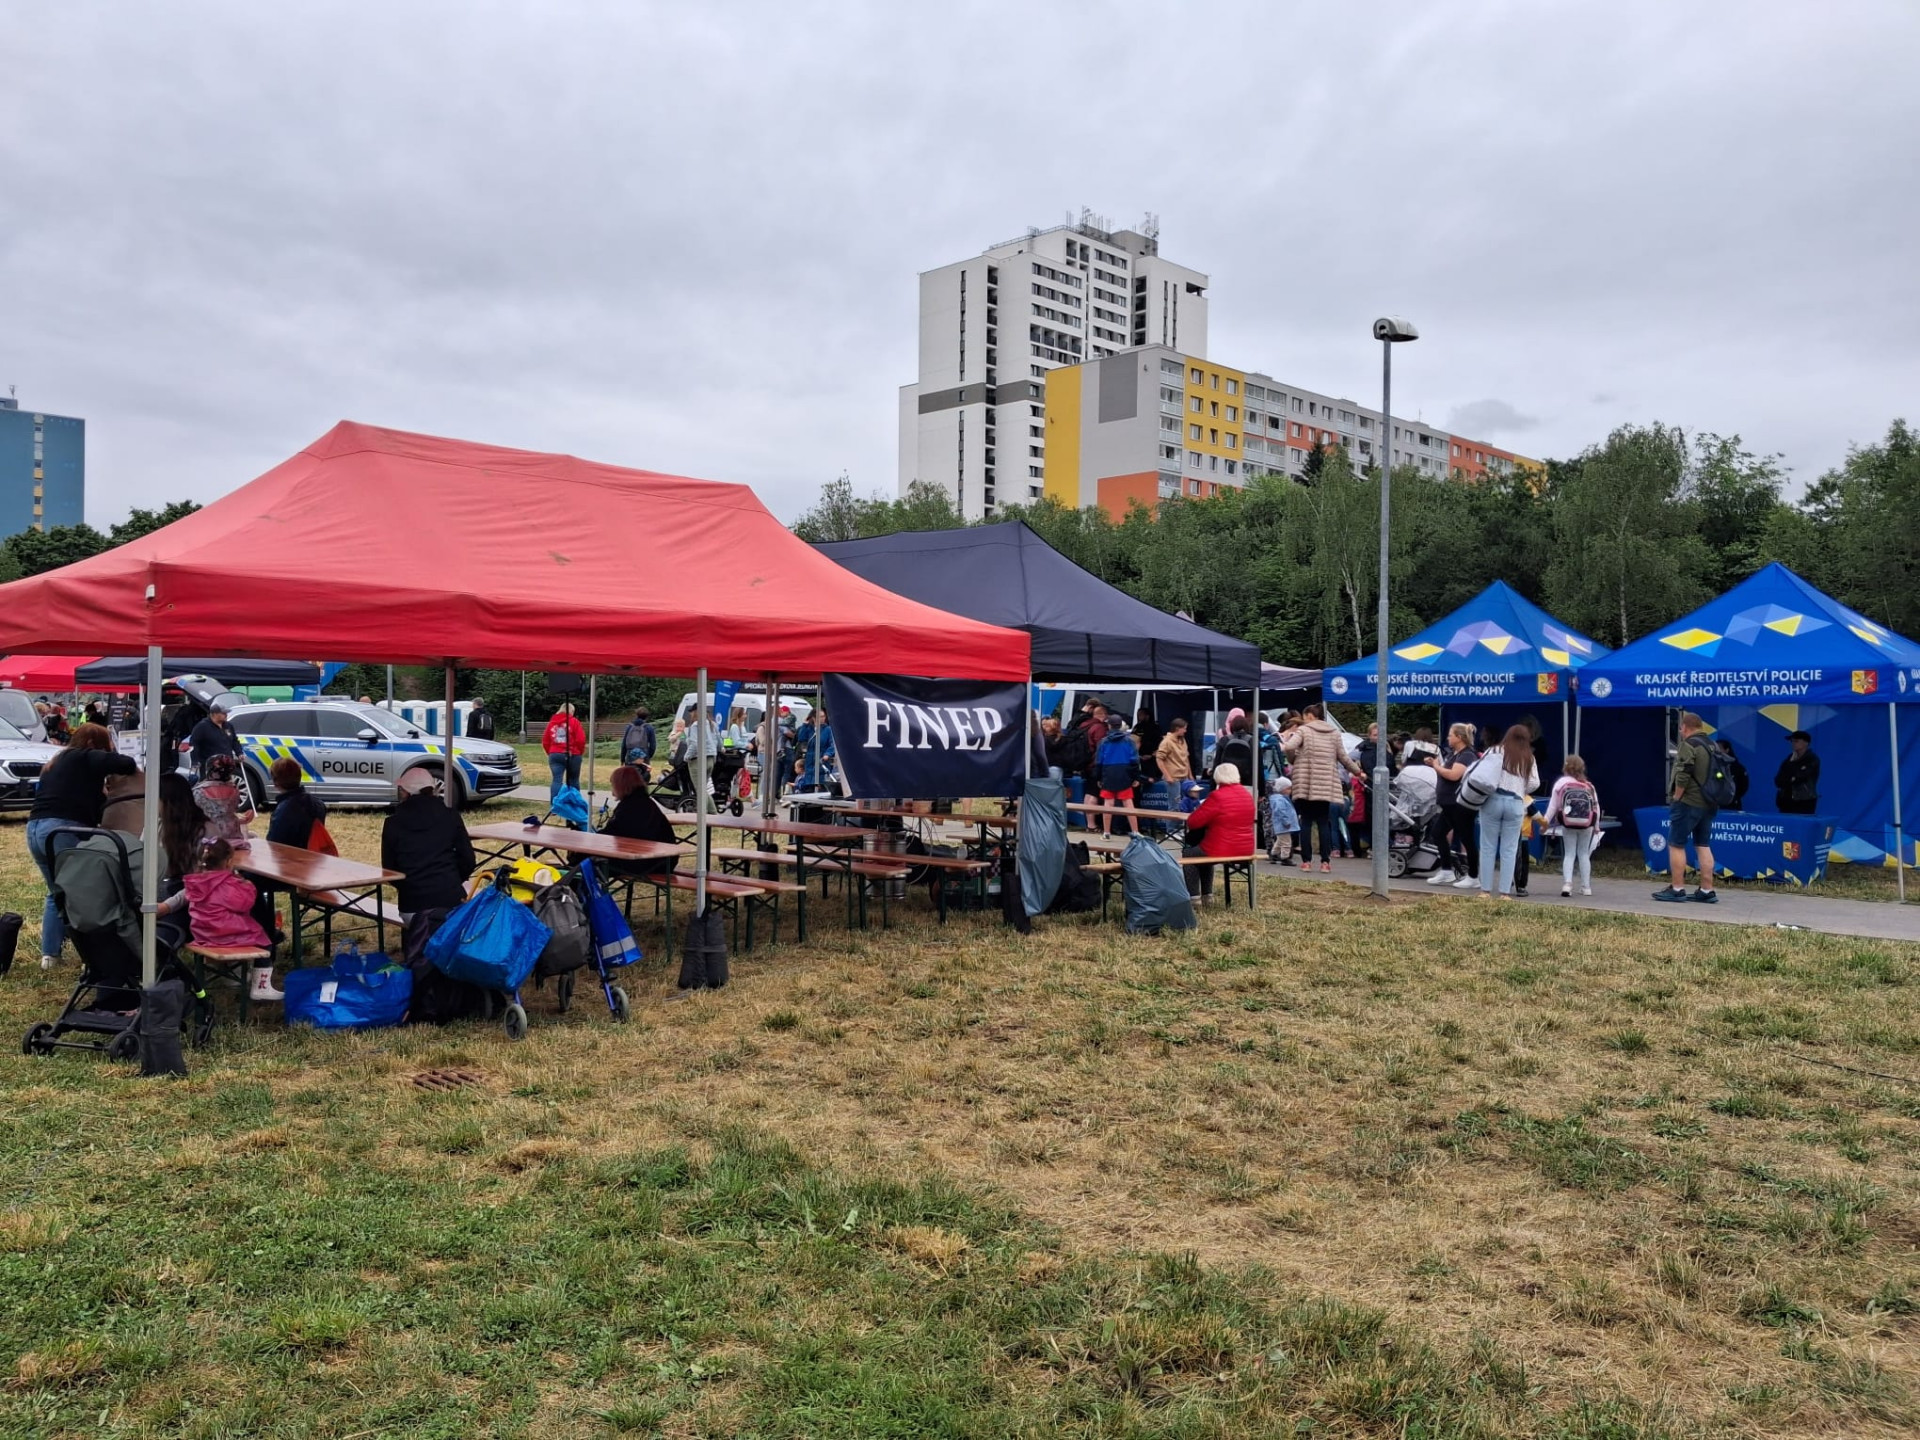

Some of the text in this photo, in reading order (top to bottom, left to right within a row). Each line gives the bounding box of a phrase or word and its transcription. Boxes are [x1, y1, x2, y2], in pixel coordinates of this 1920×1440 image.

[1366, 672, 1515, 684] KRJSKÉ ŘEDITELSTVÍ POLICIE
[1635, 669, 1822, 685] KRAJSKÉ ŘEDITELSTVÍ POLICIE
[1381, 684, 1505, 696] AVNÍHO MĚSTA PRAHY
[1647, 682, 1809, 698] HLAVNÍHO MĚSTA PRAHY
[863, 697, 1003, 751] FINEP
[322, 761, 384, 774] POLICIE
[1711, 821, 1784, 834] ITELSTVÍ POLICIE
[1715, 831, 1744, 842] MĚSTA
[1745, 834, 1776, 844] PRAHY
